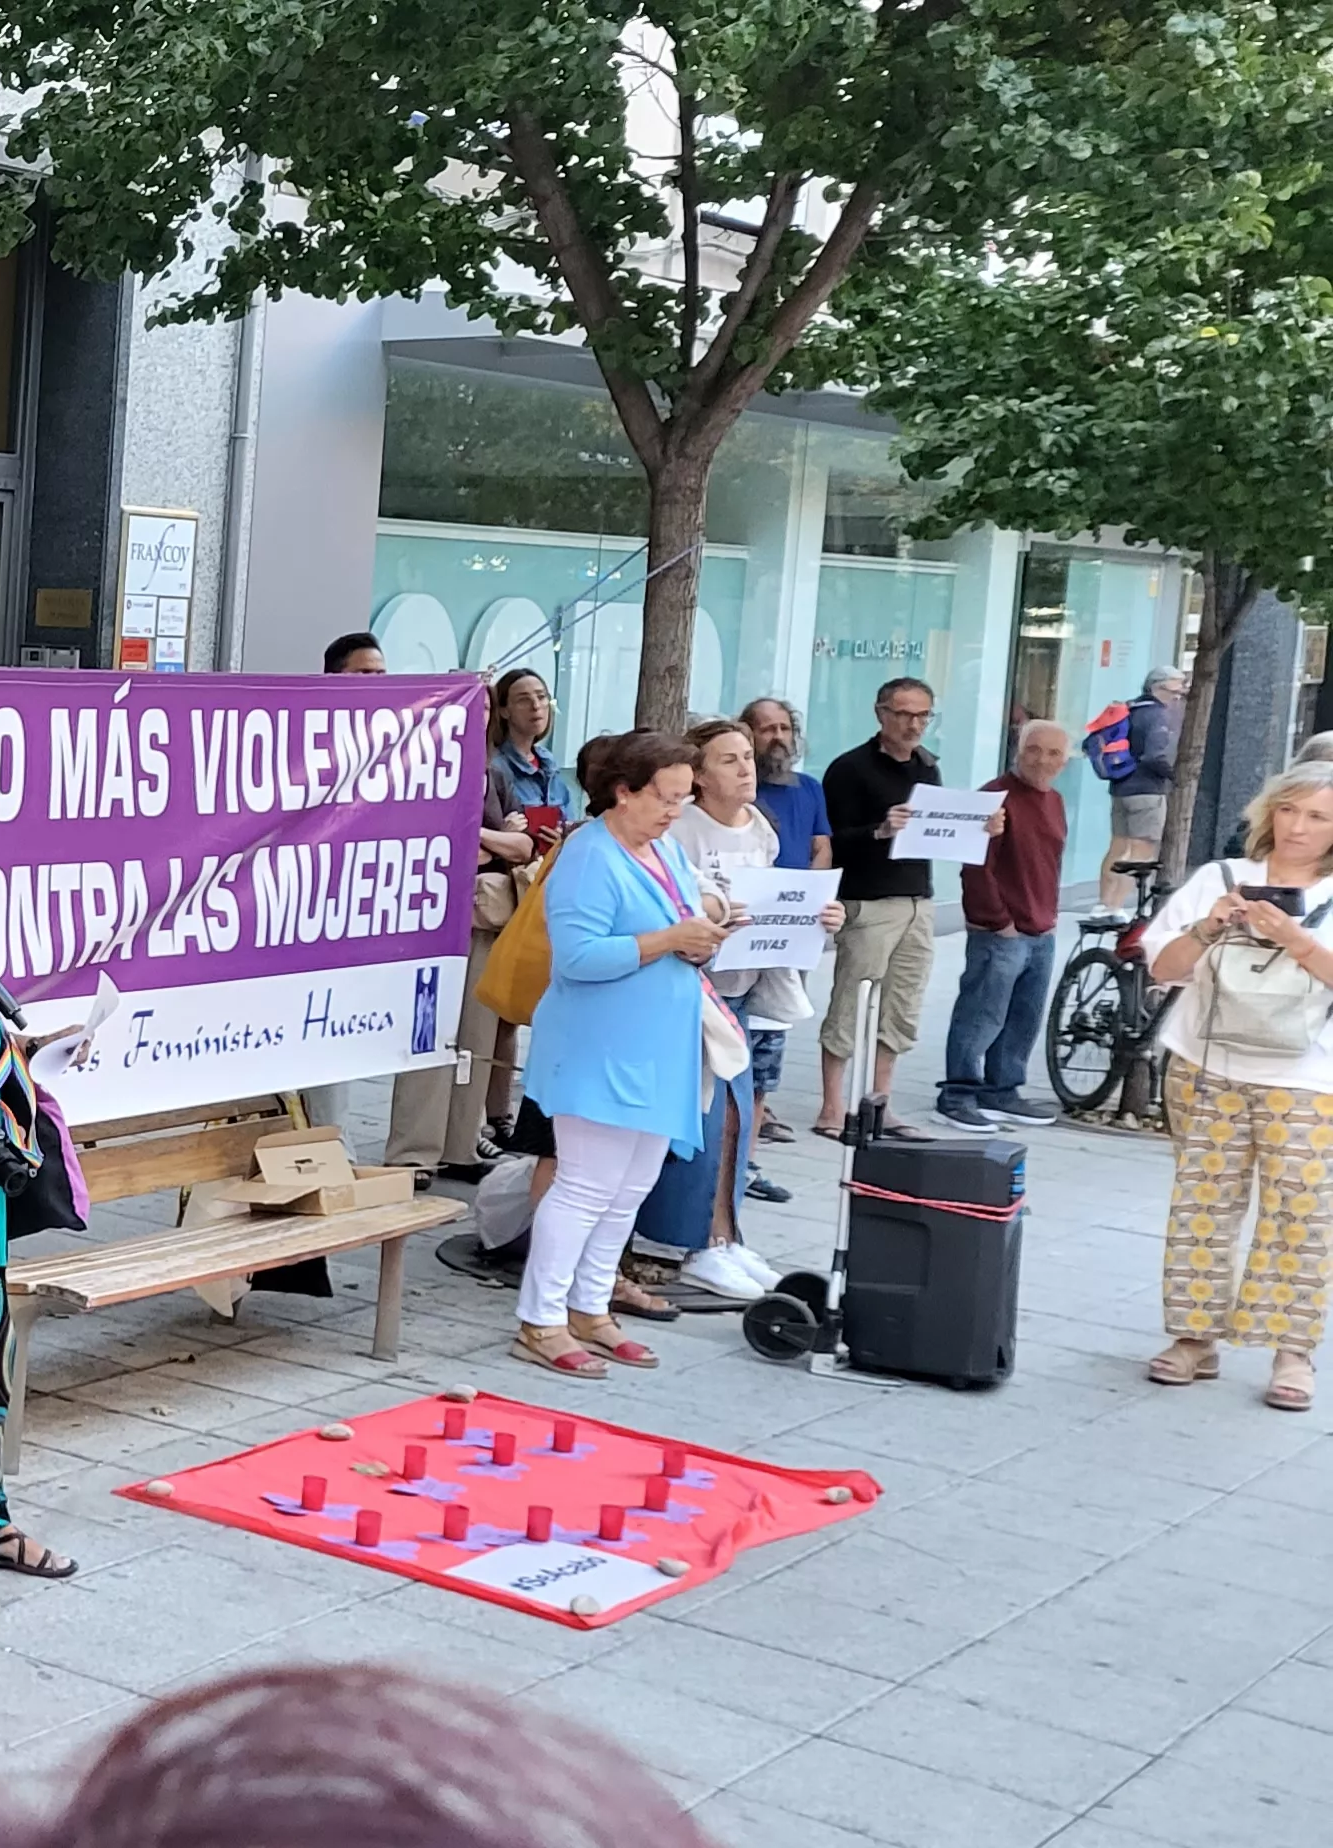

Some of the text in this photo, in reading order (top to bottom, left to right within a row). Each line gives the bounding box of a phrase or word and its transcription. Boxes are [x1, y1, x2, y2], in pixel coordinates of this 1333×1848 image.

[48, 677, 171, 820] MÁS
[190, 703, 469, 816] VIOLENCIAS
[923, 827, 957, 838] MATA
[146, 852, 242, 959] LAS
[250, 835, 452, 949] MUJERES
[776, 890, 806, 903] NOS
[749, 939, 790, 952] VIVAS
[123, 1009, 285, 1068] Feministas
[301, 987, 395, 1041] Huesca
